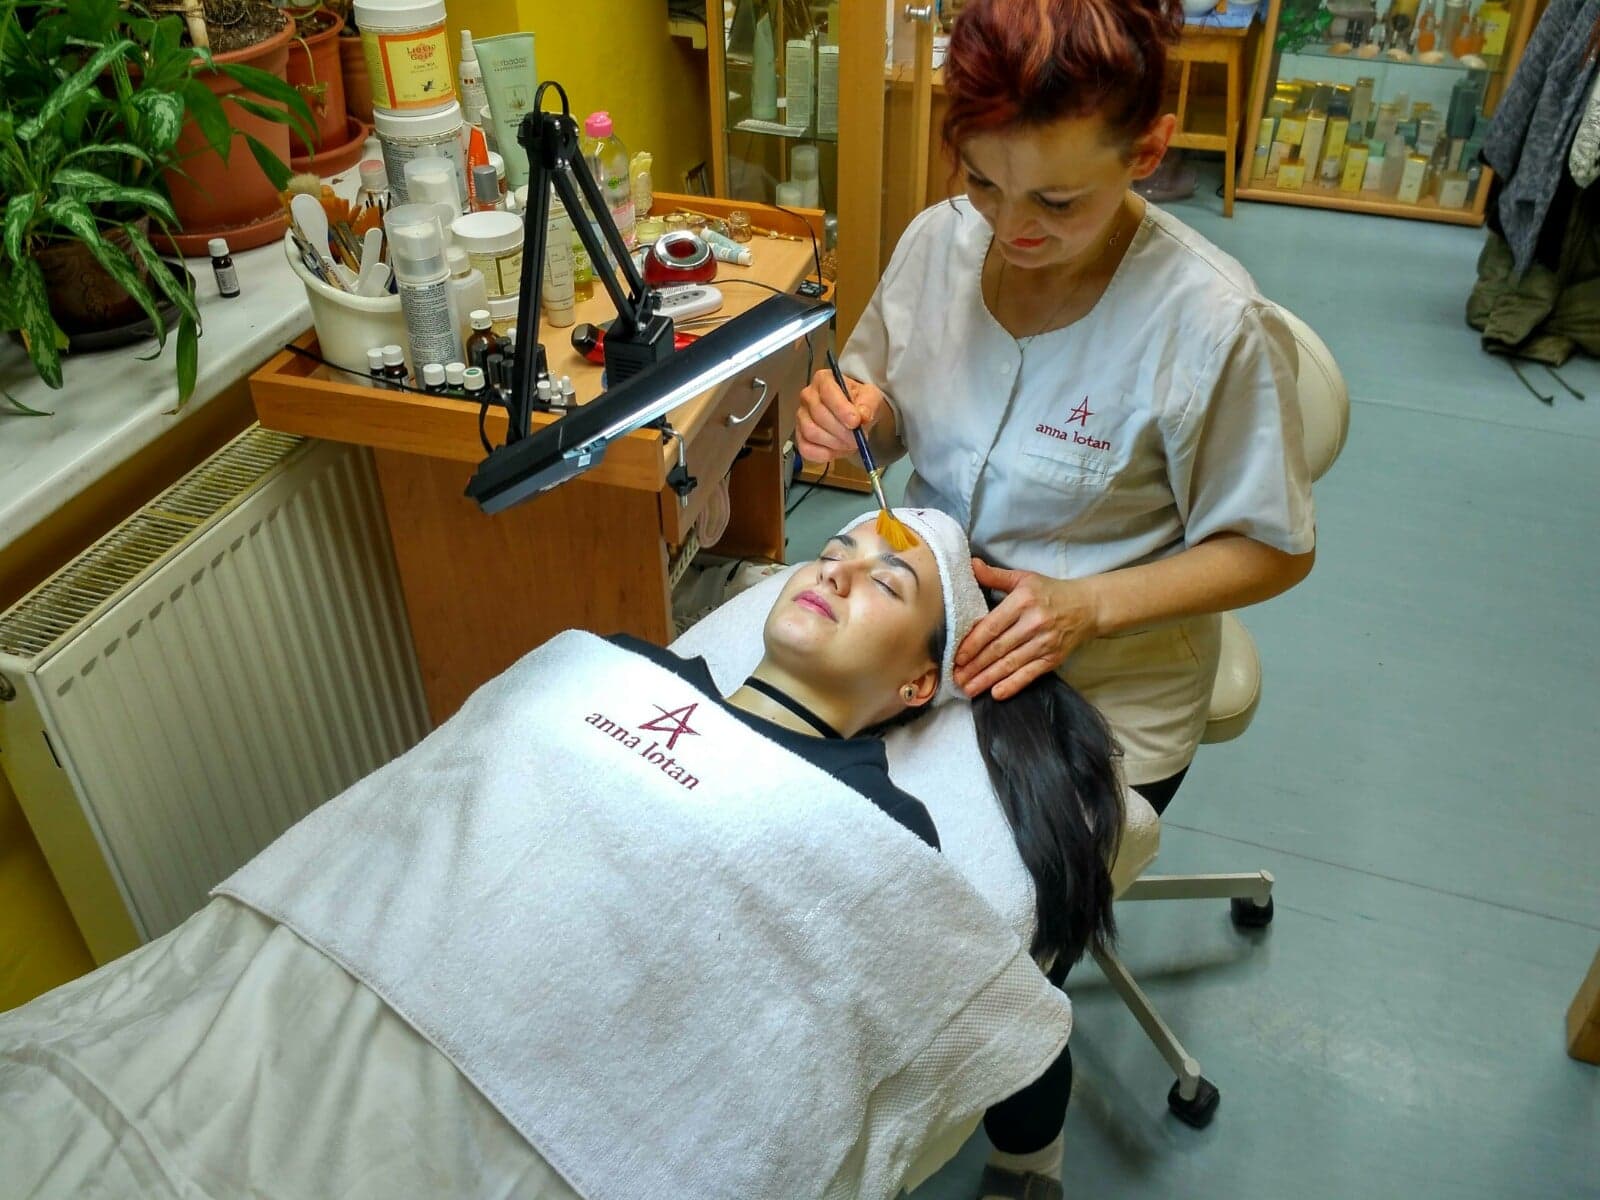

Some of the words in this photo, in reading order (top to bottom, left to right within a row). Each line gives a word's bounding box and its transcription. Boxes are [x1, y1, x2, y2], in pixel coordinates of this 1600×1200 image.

[1035, 423, 1068, 441] anna
[1073, 430, 1111, 451] lotan
[584, 712, 641, 749] anna
[639, 741, 700, 790] lotan
